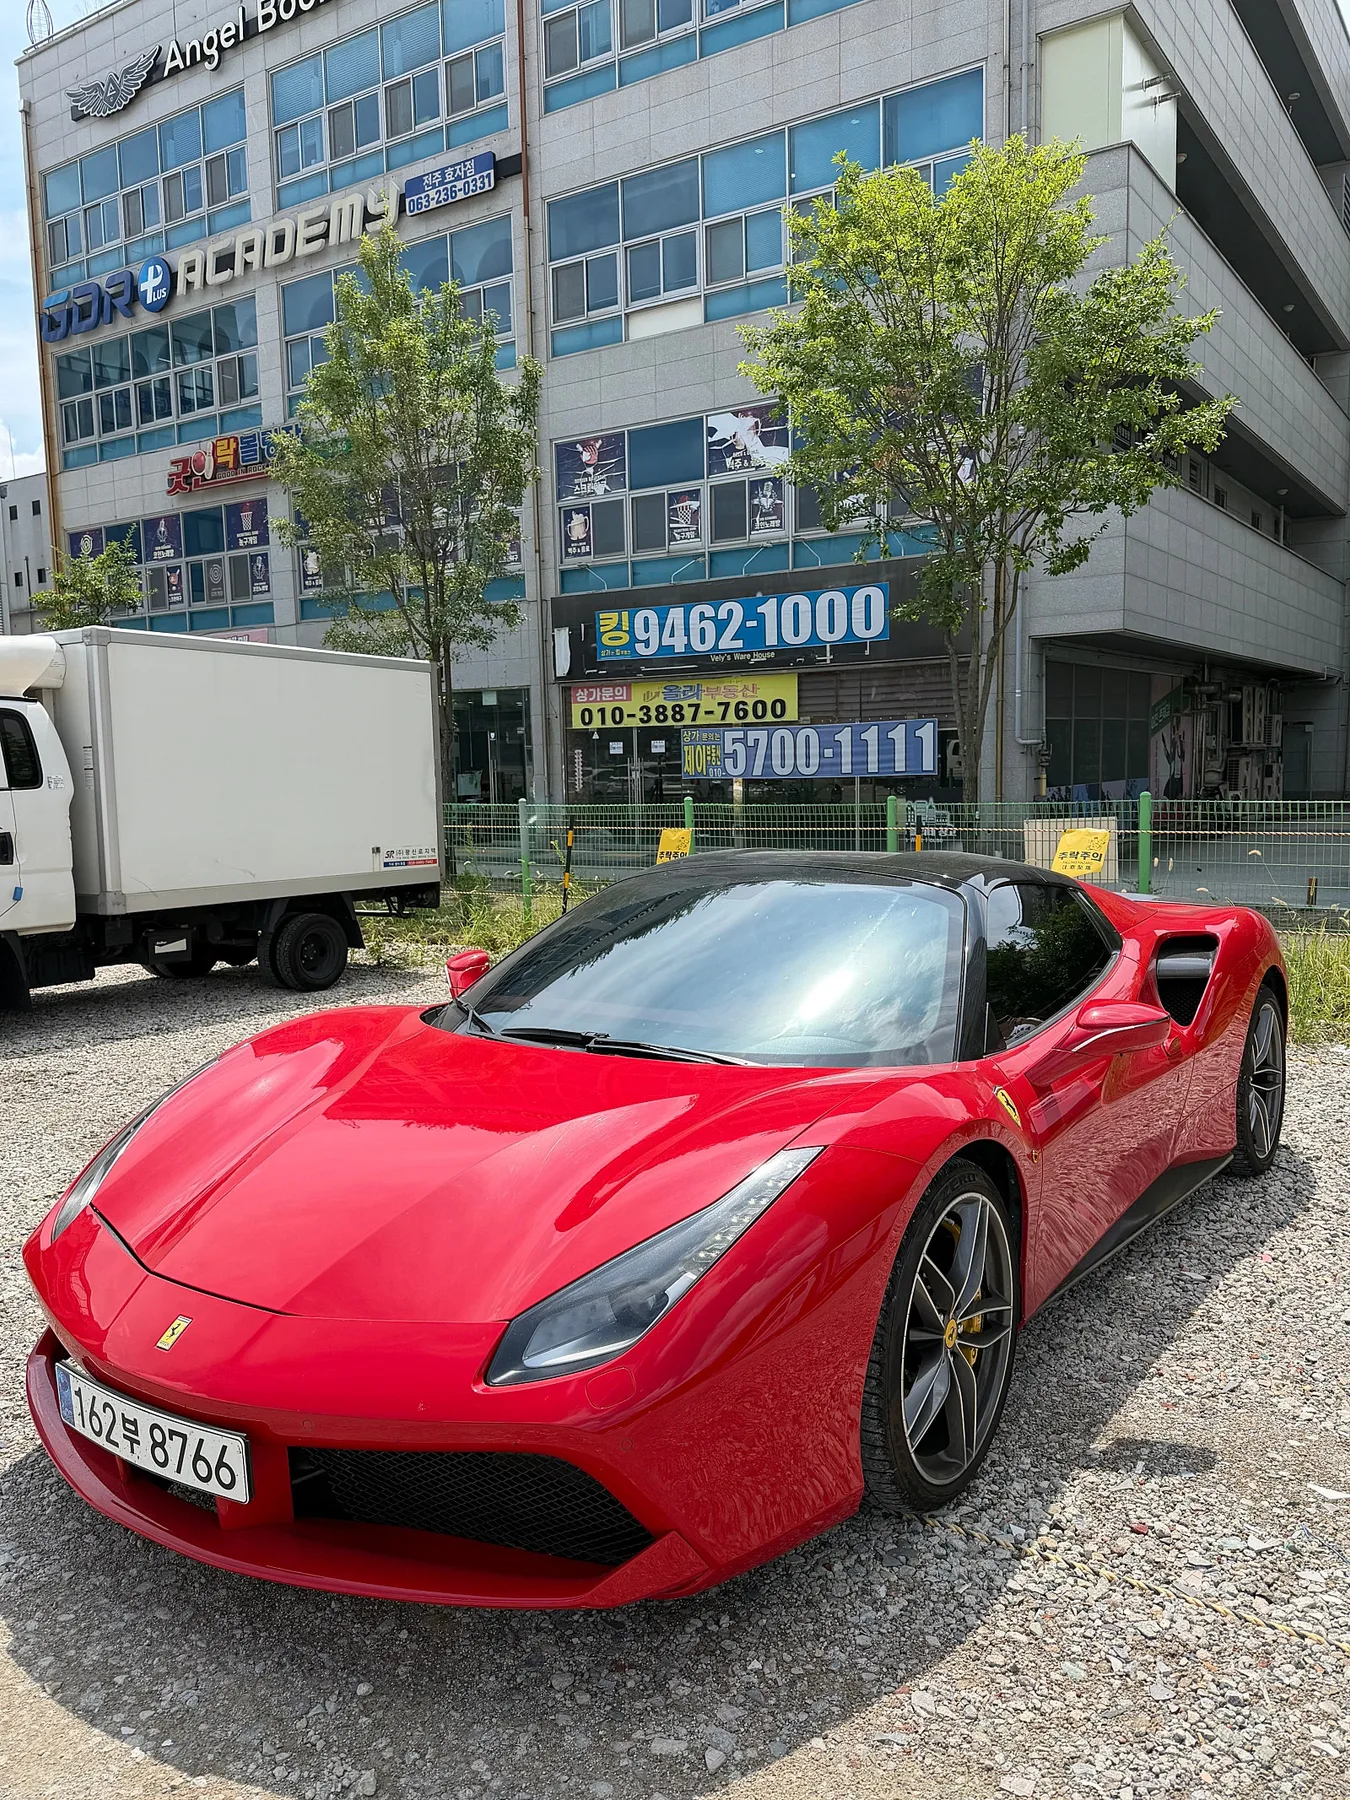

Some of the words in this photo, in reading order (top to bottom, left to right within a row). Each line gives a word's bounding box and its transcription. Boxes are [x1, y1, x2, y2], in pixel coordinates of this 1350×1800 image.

[163, 6, 246, 71] Angel
[422, 170, 443, 191] 전주
[444, 159, 476, 184] 효자점
[408, 171, 493, 214] 063-236-0331
[41, 270, 136, 343] GDR
[177, 182, 400, 296] ACADEMY
[238, 467, 247, 476] IN
[599, 611, 629, 646] 킹
[634, 586, 885, 656] 9462-1000
[710, 653, 731, 662] Vely's
[733, 652, 751, 660] Ware
[753, 650, 775, 659] House
[576, 686, 628, 702] 상가문의
[580, 698, 786, 726] 010-3887-7600
[683, 730, 699, 742] 상가
[724, 722, 934, 776] 5700-1111
[1058, 851, 1102, 862] 추락주의
[74, 1386, 140, 1454] 162부
[150, 1423, 236, 1490] 8766
